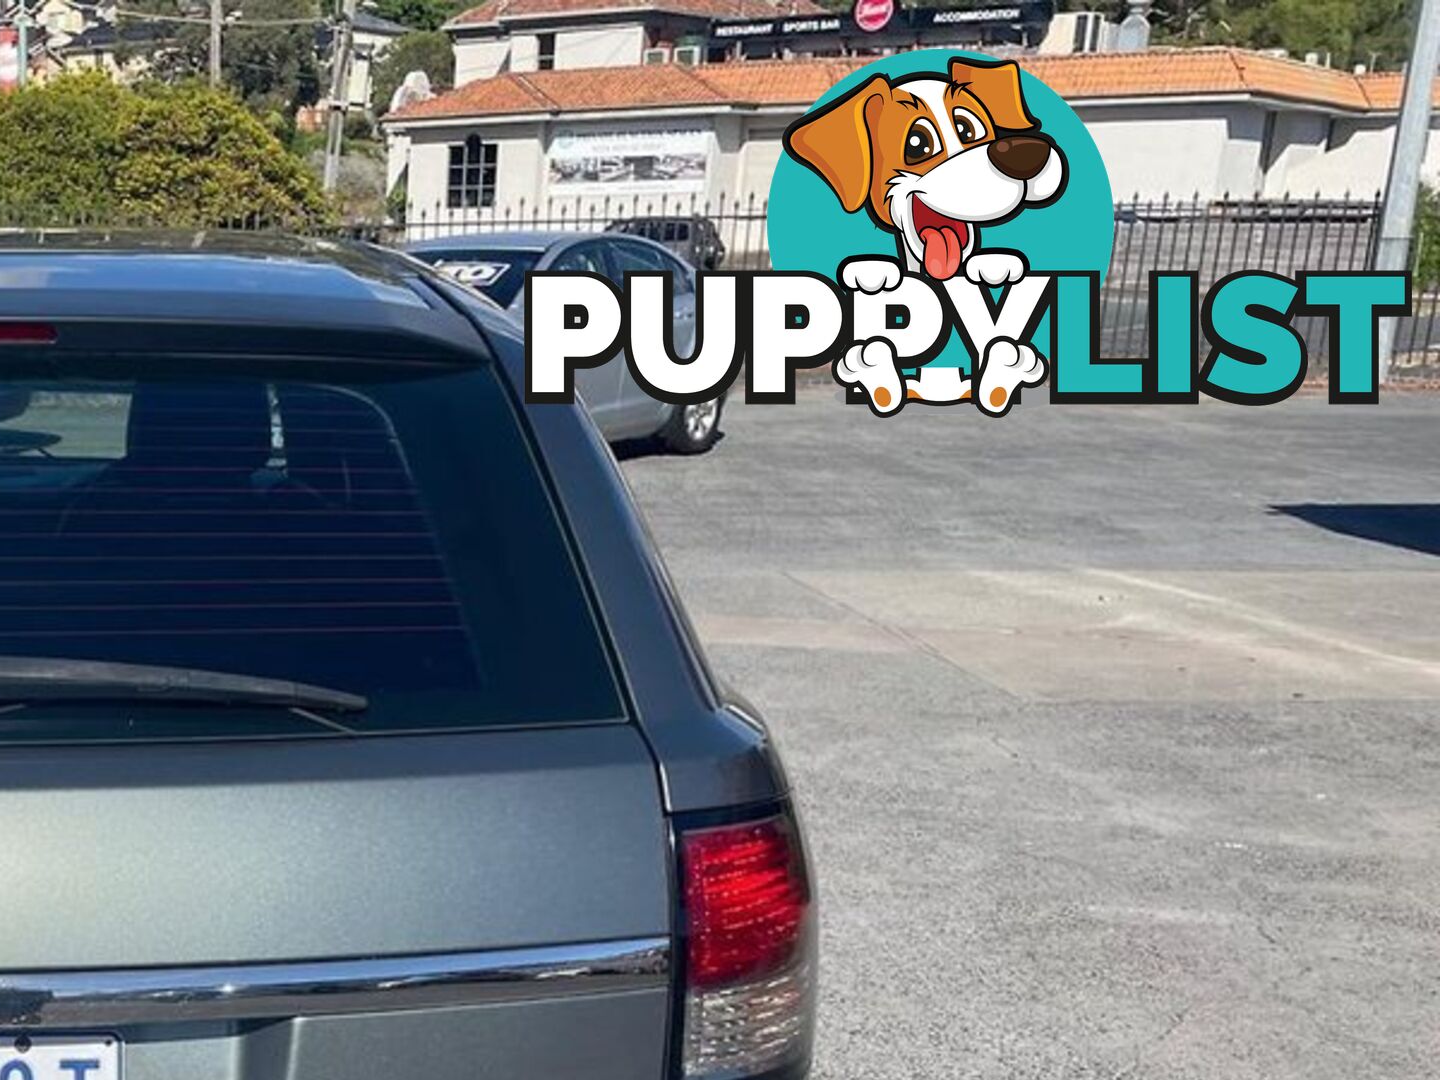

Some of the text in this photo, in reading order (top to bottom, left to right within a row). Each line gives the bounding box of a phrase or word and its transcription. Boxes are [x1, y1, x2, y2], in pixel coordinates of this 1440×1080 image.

[933, 9, 1020, 22] ACCOMMODATION
[782, 19, 840, 32] SPORTS BAR
